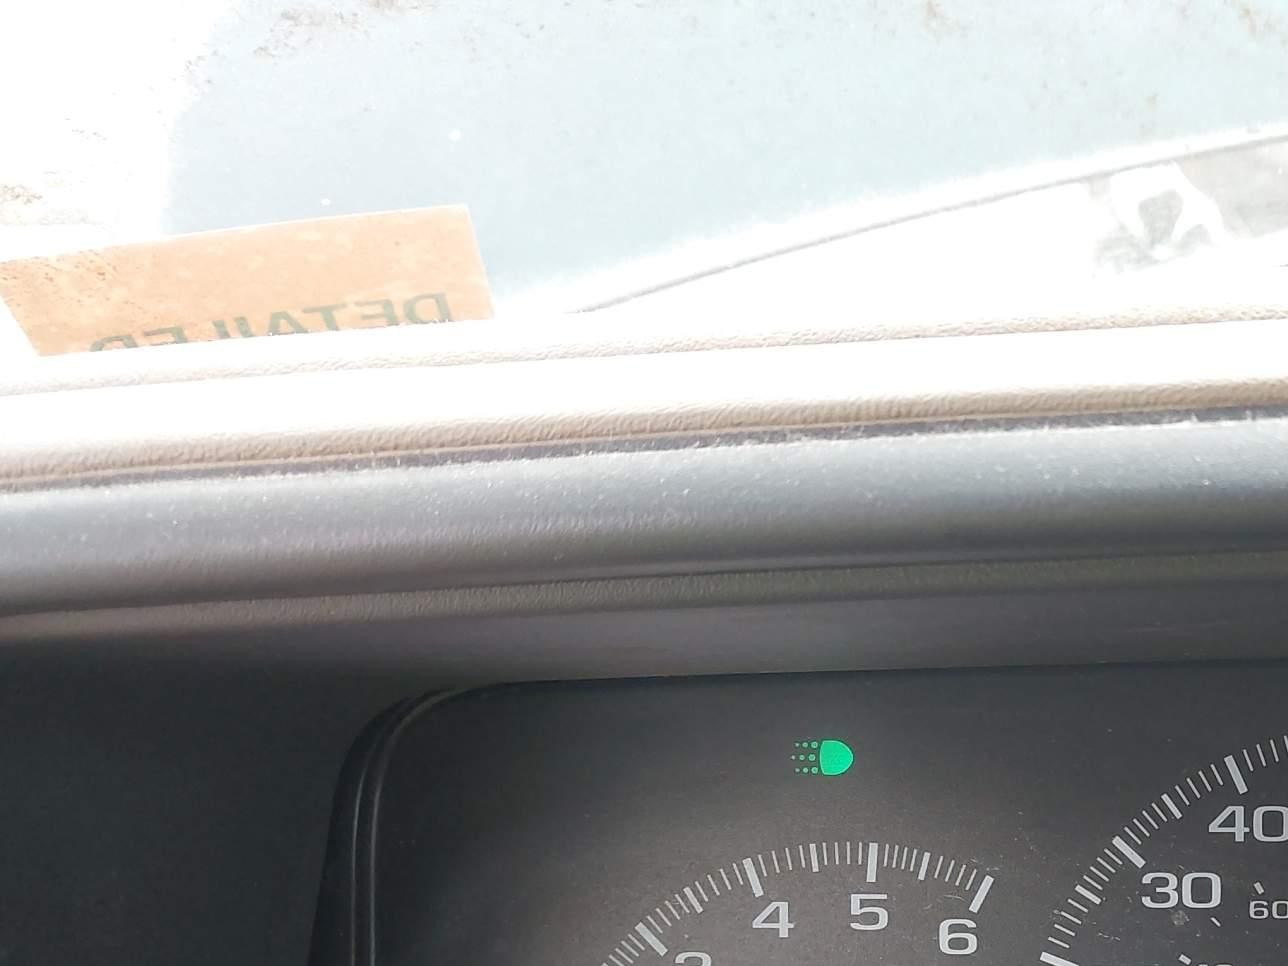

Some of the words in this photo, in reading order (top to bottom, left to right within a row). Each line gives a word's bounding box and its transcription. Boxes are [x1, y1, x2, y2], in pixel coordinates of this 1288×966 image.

[1141, 872, 1222, 909] 30
[752, 901, 795, 938] 4
[850, 893, 889, 931] 5
[938, 918, 978, 955] 6
